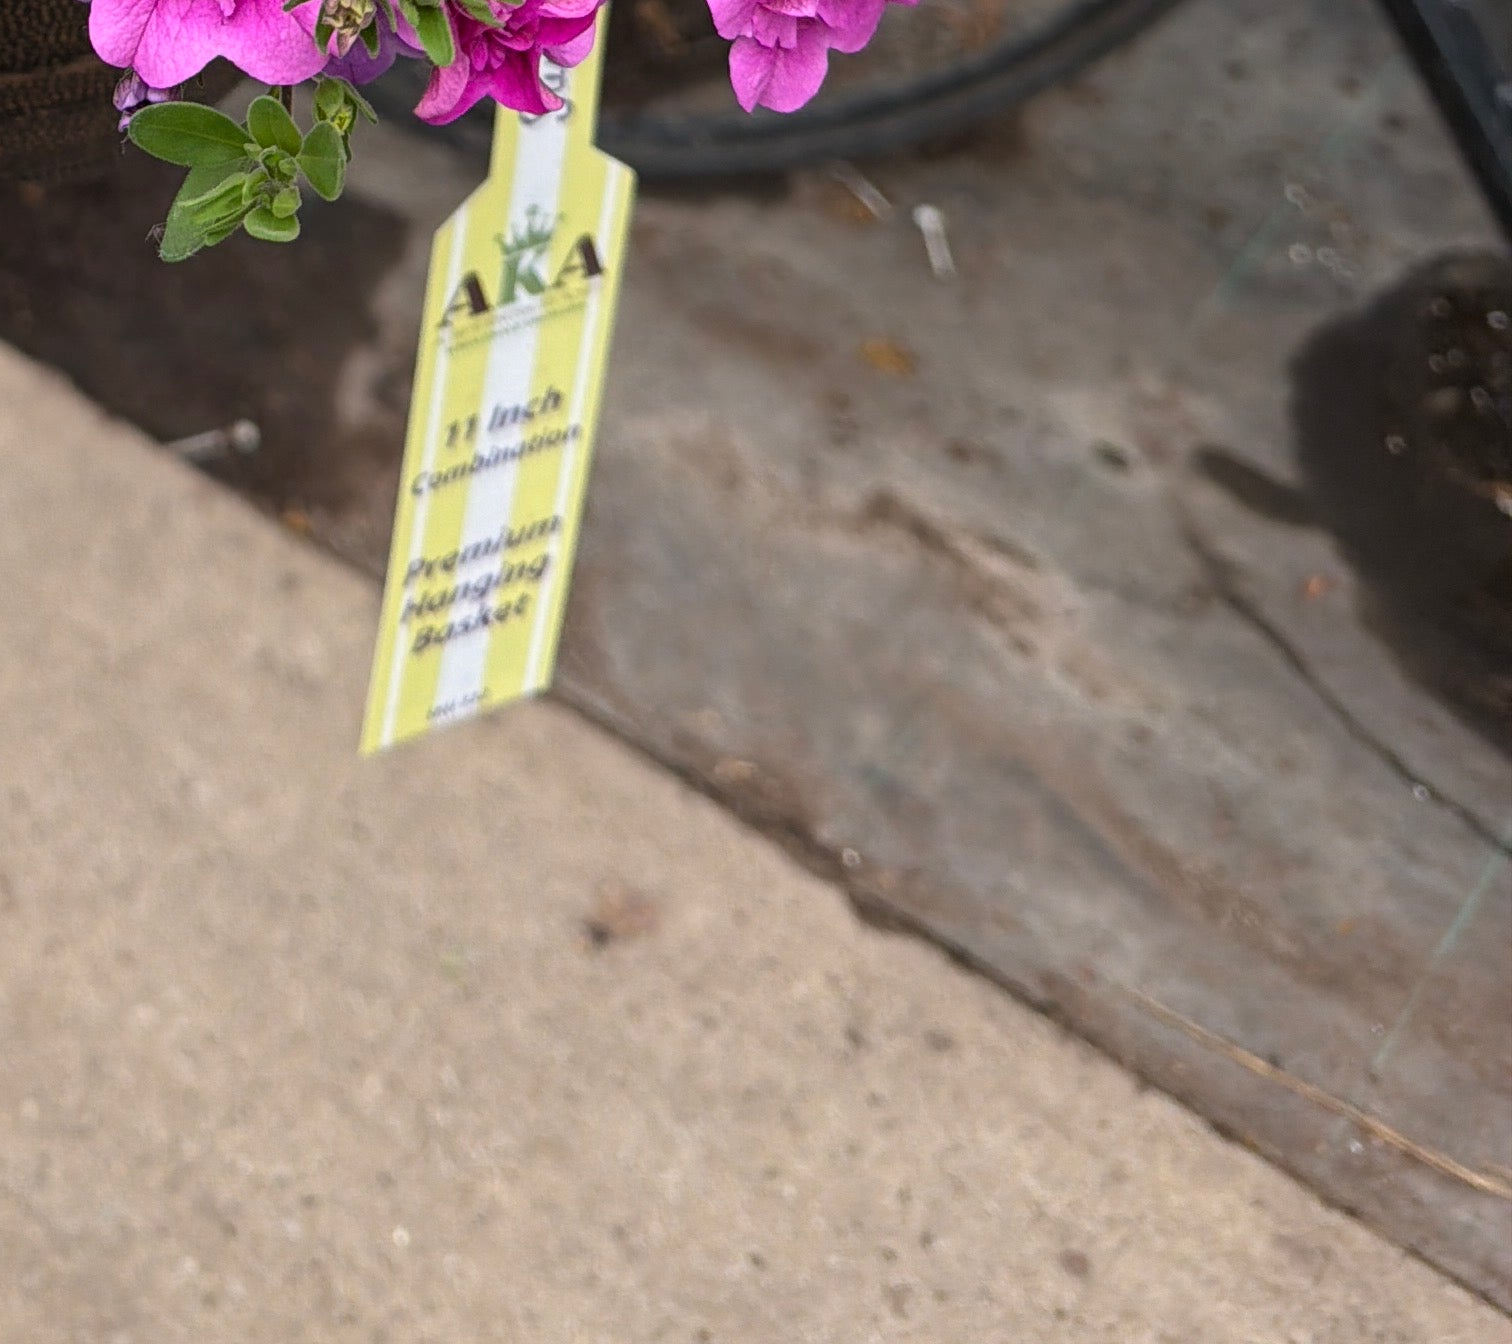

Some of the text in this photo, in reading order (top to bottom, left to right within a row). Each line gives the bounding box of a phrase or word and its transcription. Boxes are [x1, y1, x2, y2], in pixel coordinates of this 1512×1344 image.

[436, 230, 604, 327] AKA
[403, 514, 562, 587] Premium
[399, 554, 551, 625] Hanging
[411, 592, 531, 655] Basket
